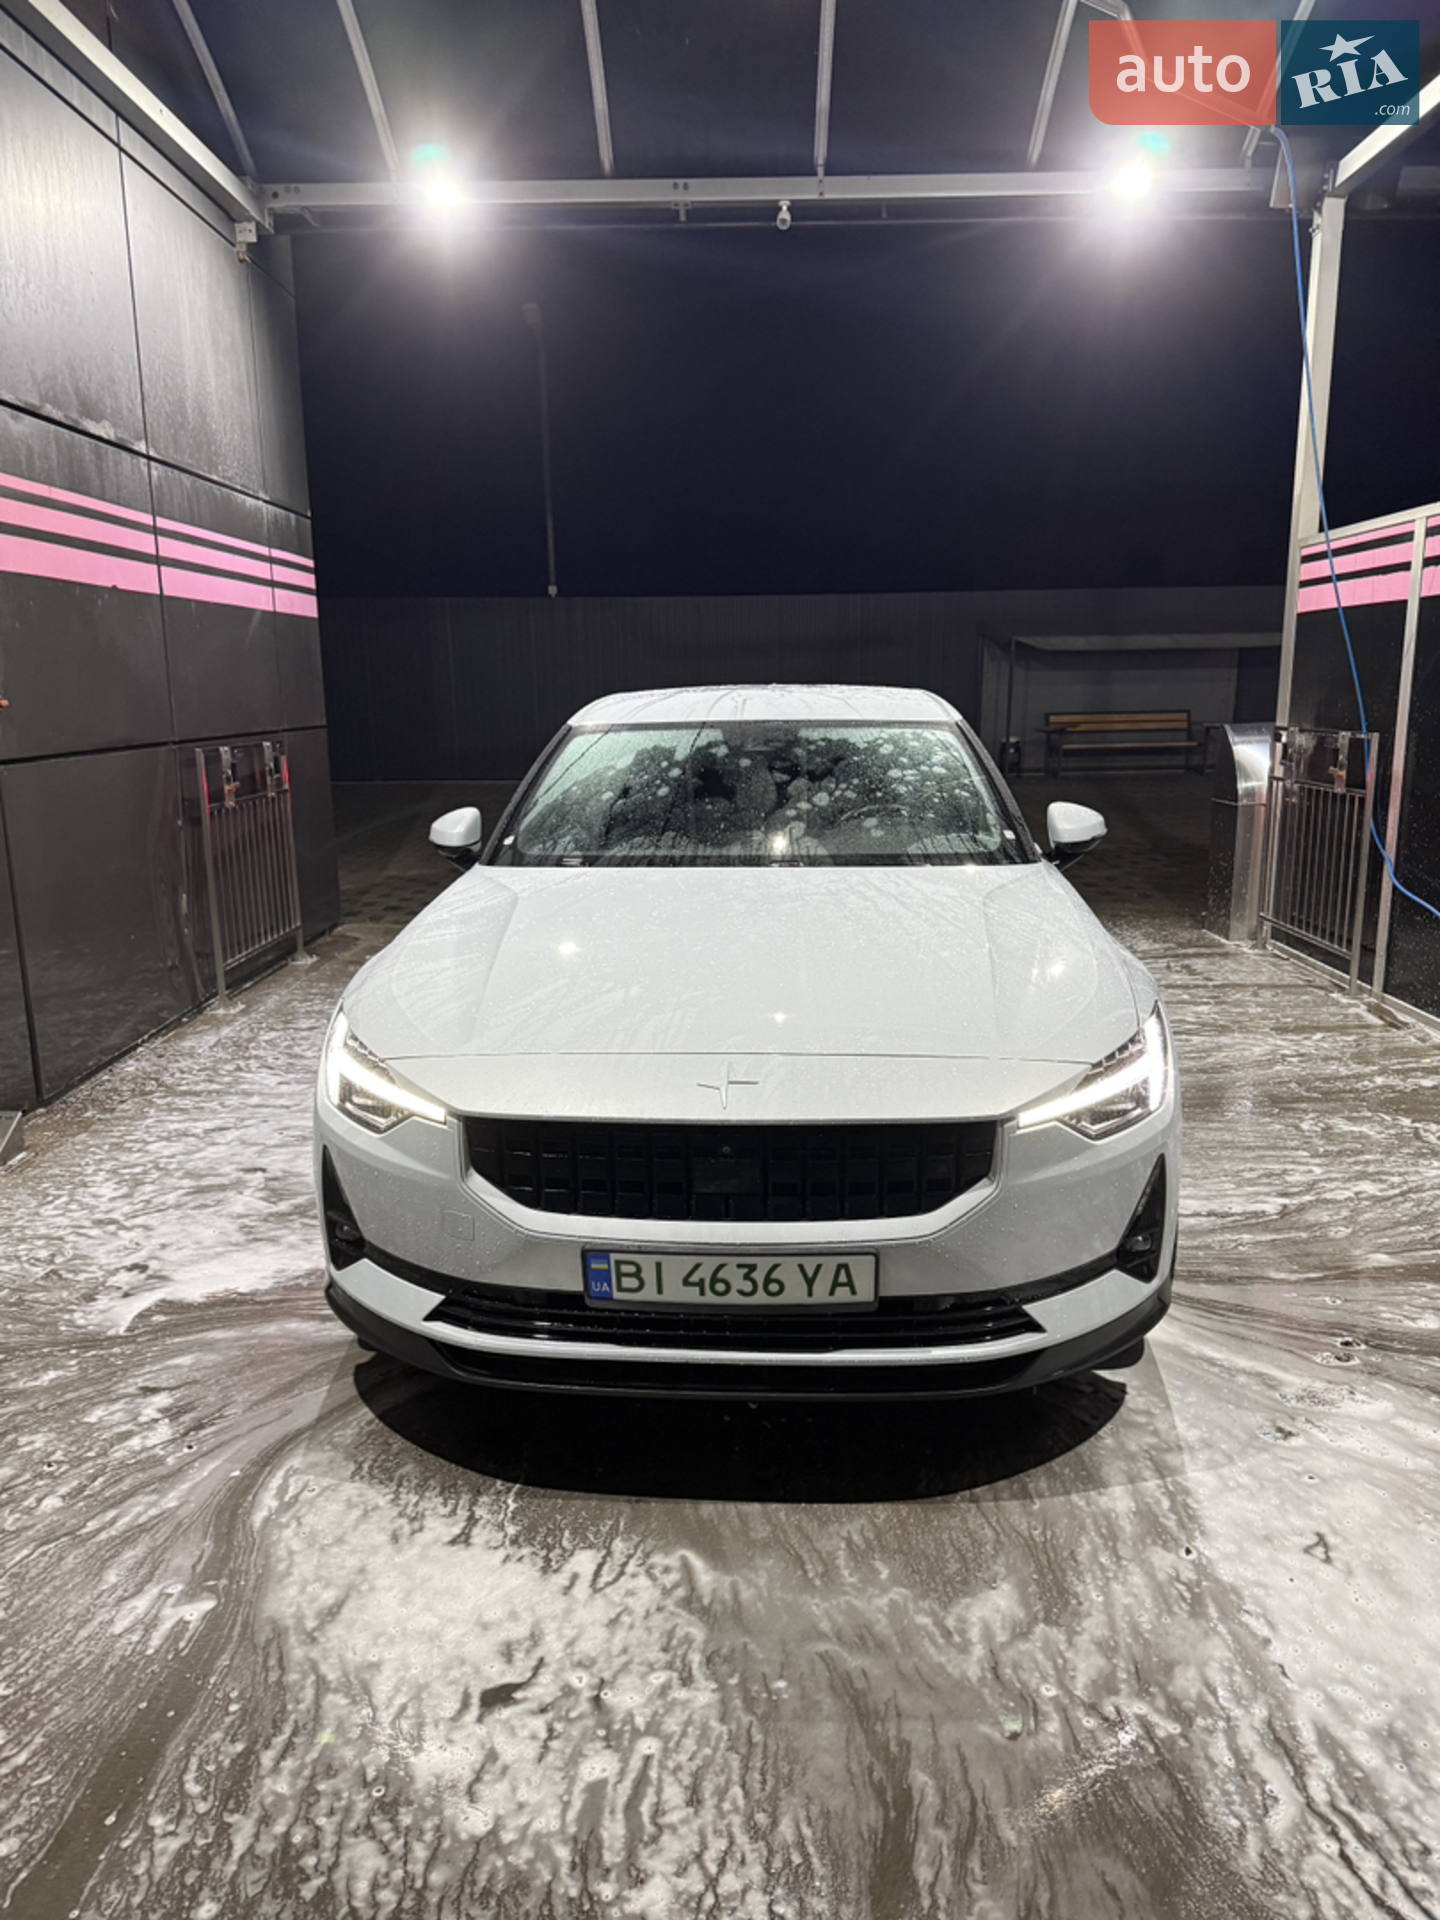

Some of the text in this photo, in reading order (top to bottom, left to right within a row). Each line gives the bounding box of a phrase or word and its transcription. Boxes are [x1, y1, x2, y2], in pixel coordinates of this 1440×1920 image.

[592, 1282, 610, 1292] UA
[614, 1259, 857, 1297] BI 4636 YA
